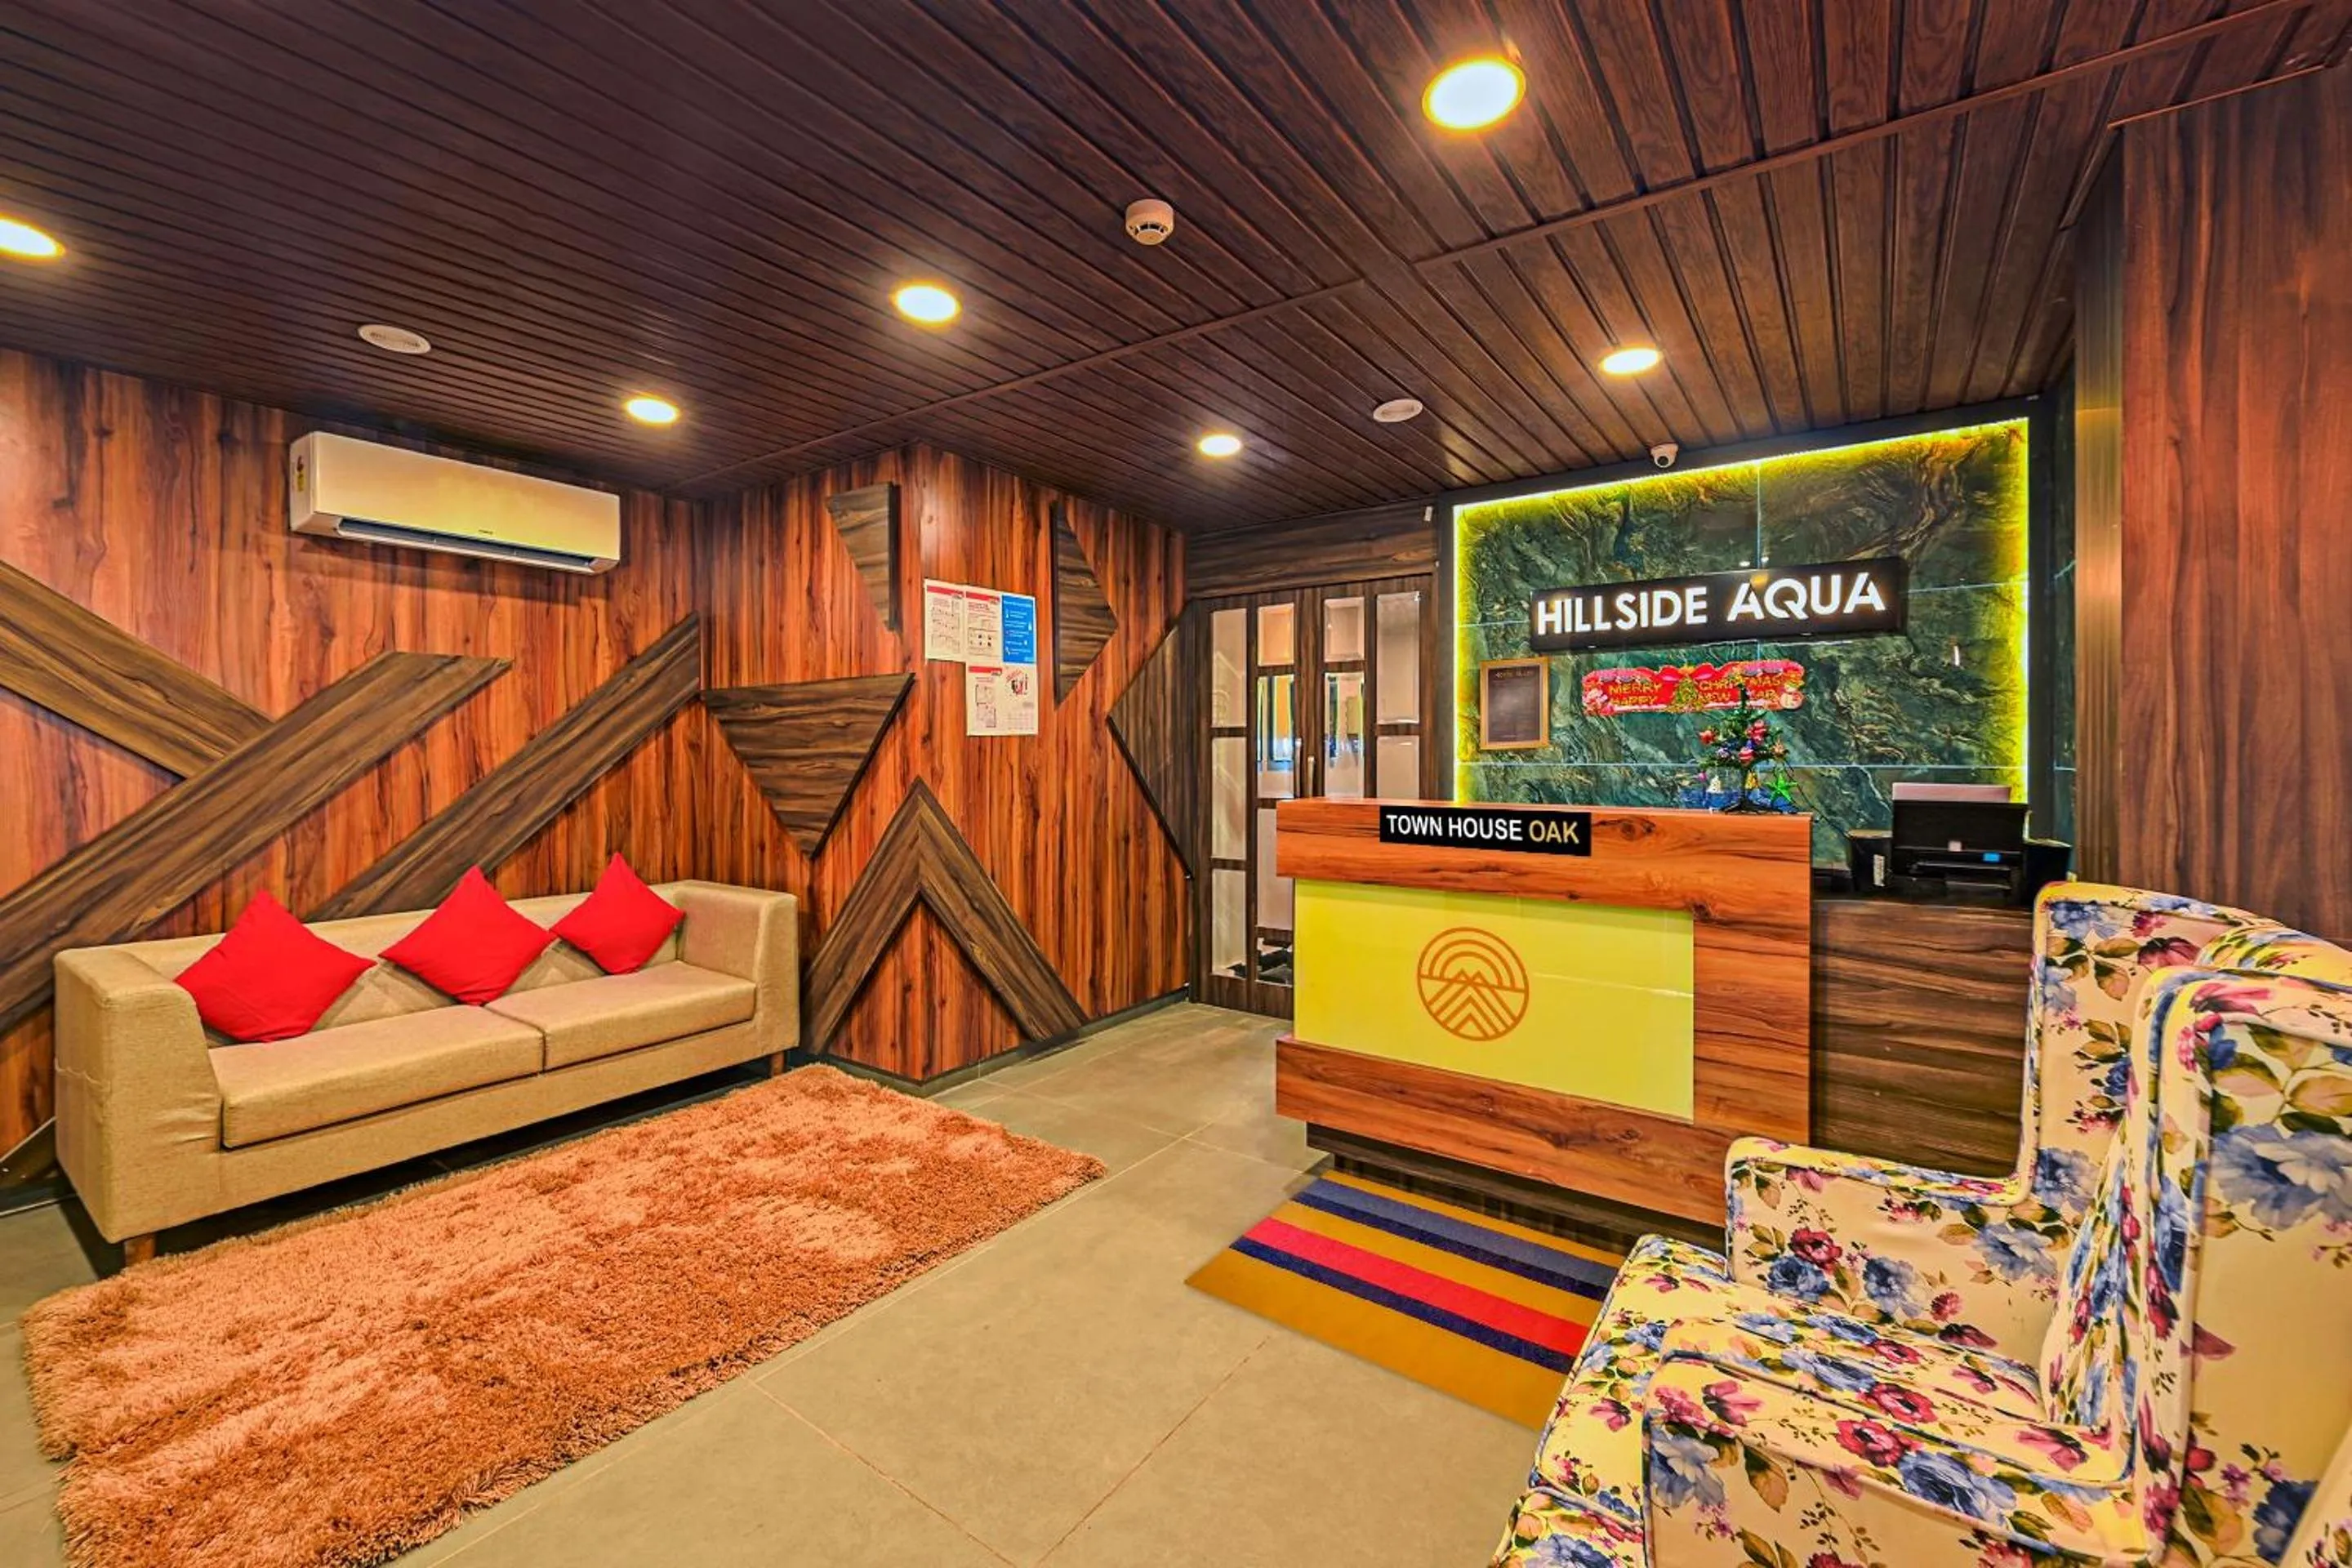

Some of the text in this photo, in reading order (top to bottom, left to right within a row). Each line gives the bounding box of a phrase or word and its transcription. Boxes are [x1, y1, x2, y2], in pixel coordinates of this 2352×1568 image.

[1536, 572, 1886, 635] HILLSIDE AQUA
[1609, 676, 1780, 694] MERRY CHRIMAS
[1386, 814, 1580, 844] TOWN HOUSE OAK
